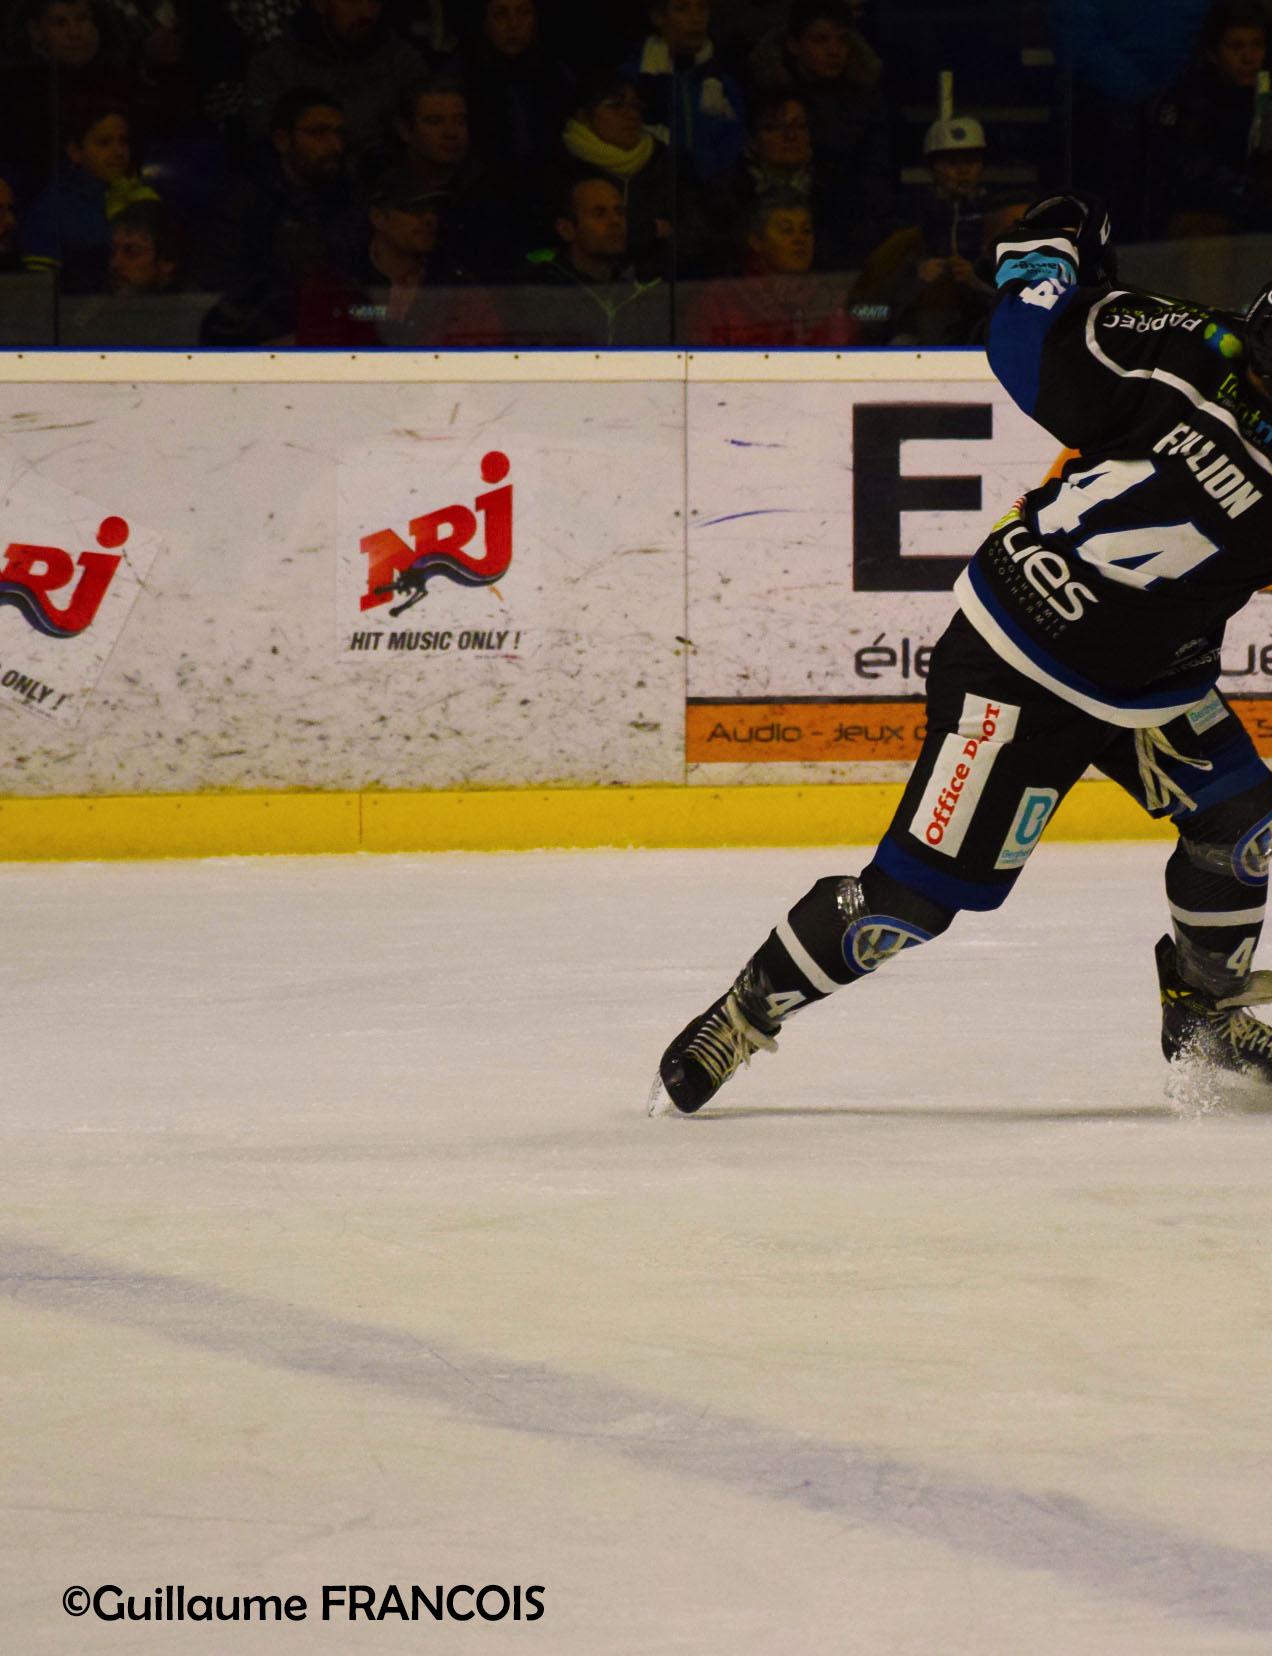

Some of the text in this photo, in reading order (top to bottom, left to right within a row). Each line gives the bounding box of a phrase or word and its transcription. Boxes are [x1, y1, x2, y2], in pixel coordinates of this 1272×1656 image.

[1102, 302, 1203, 333] PAPREC
[1152, 422, 1263, 520] FILLION
[360, 451, 513, 612] NRJ
[1037, 459, 1219, 591] 44
[0, 515, 130, 638] RJ
[350, 632, 383, 651] HIT
[388, 631, 452, 650] MUSIC
[458, 630, 508, 649] ONLY
[1, 669, 54, 703] ONLY
[706, 722, 803, 743] Audio
[926, 703, 1001, 845] Office DOT
[1226, 936, 1256, 977] 4
[765, 990, 807, 1018] 4
